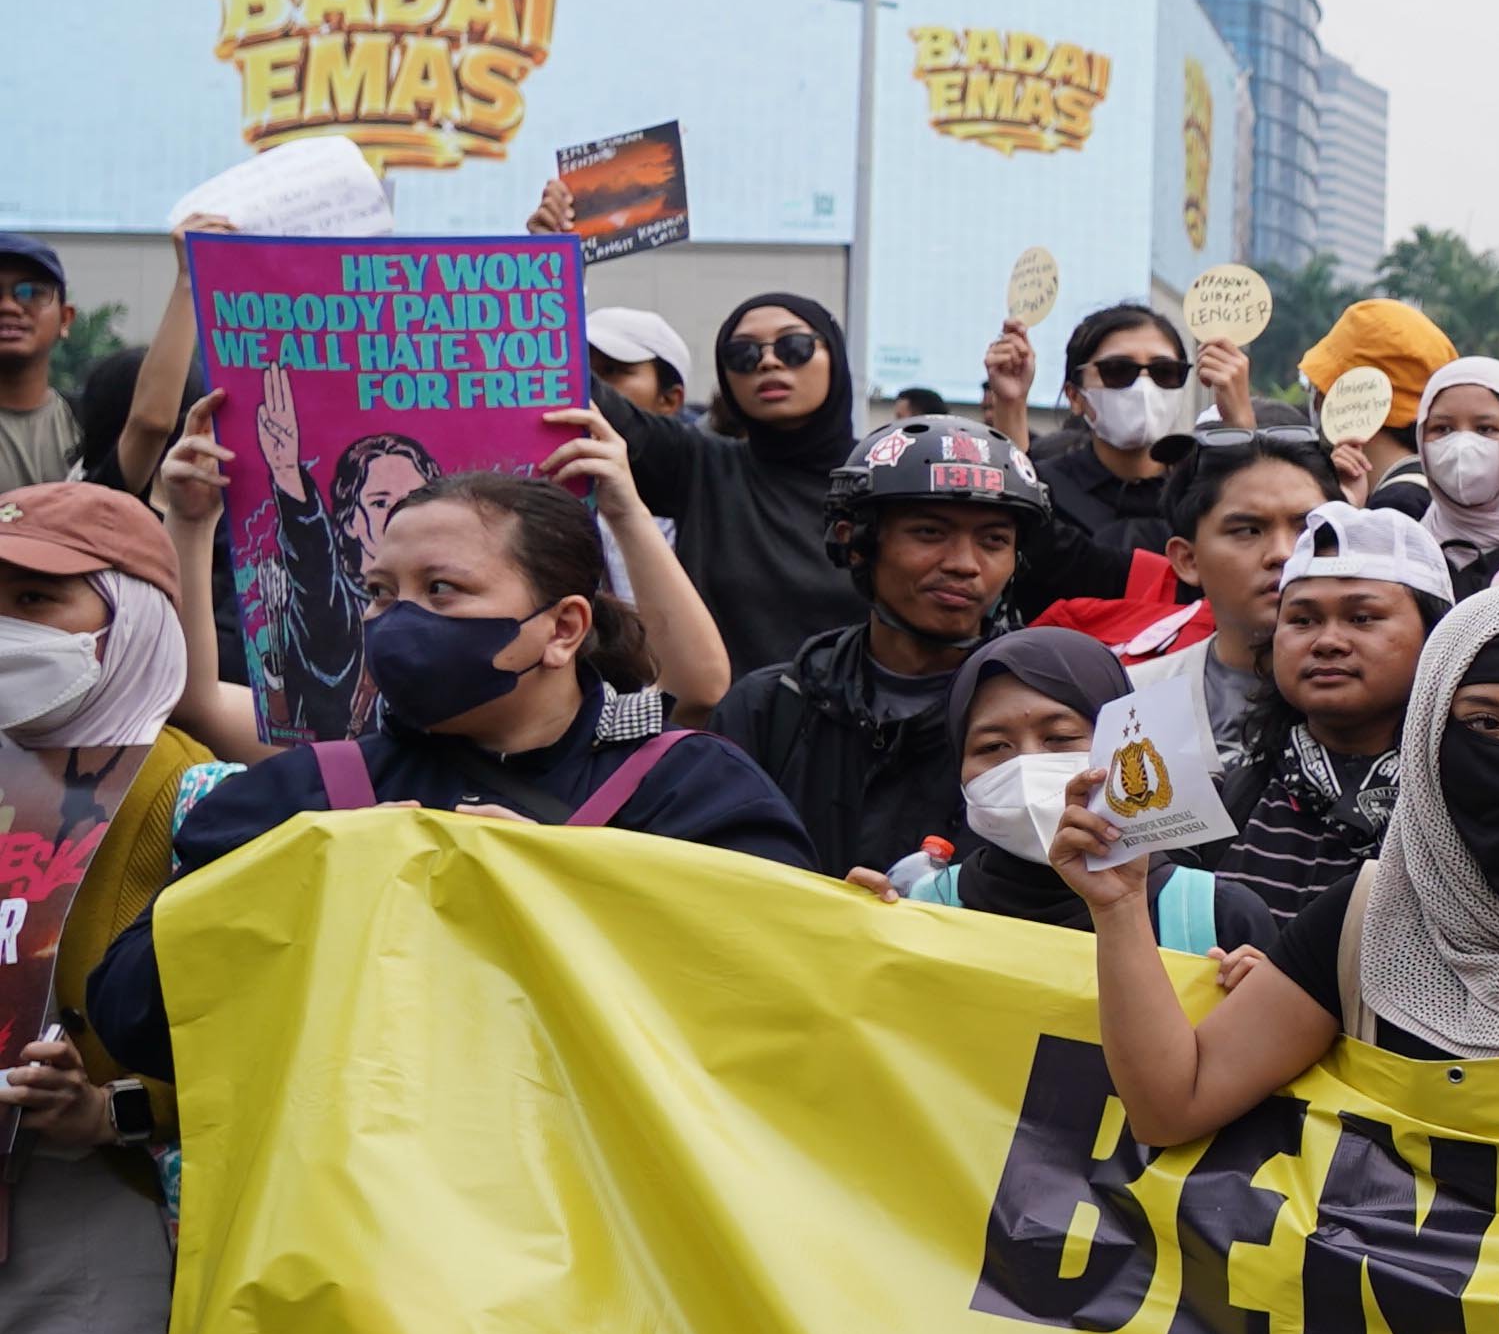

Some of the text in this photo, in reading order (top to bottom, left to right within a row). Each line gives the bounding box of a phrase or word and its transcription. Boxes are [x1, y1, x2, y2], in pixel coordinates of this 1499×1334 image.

[909, 26, 1112, 100] BADAI
[236, 30, 525, 141] EMAS
[925, 71, 1095, 140] EMAS
[341, 252, 562, 292] HEY WOK!
[212, 290, 567, 332] NOBODY PAID US
[211, 330, 569, 371] WE ALL HATE YOU
[357, 369, 572, 411] FOR FREE
[934, 466, 1001, 492] 1312
